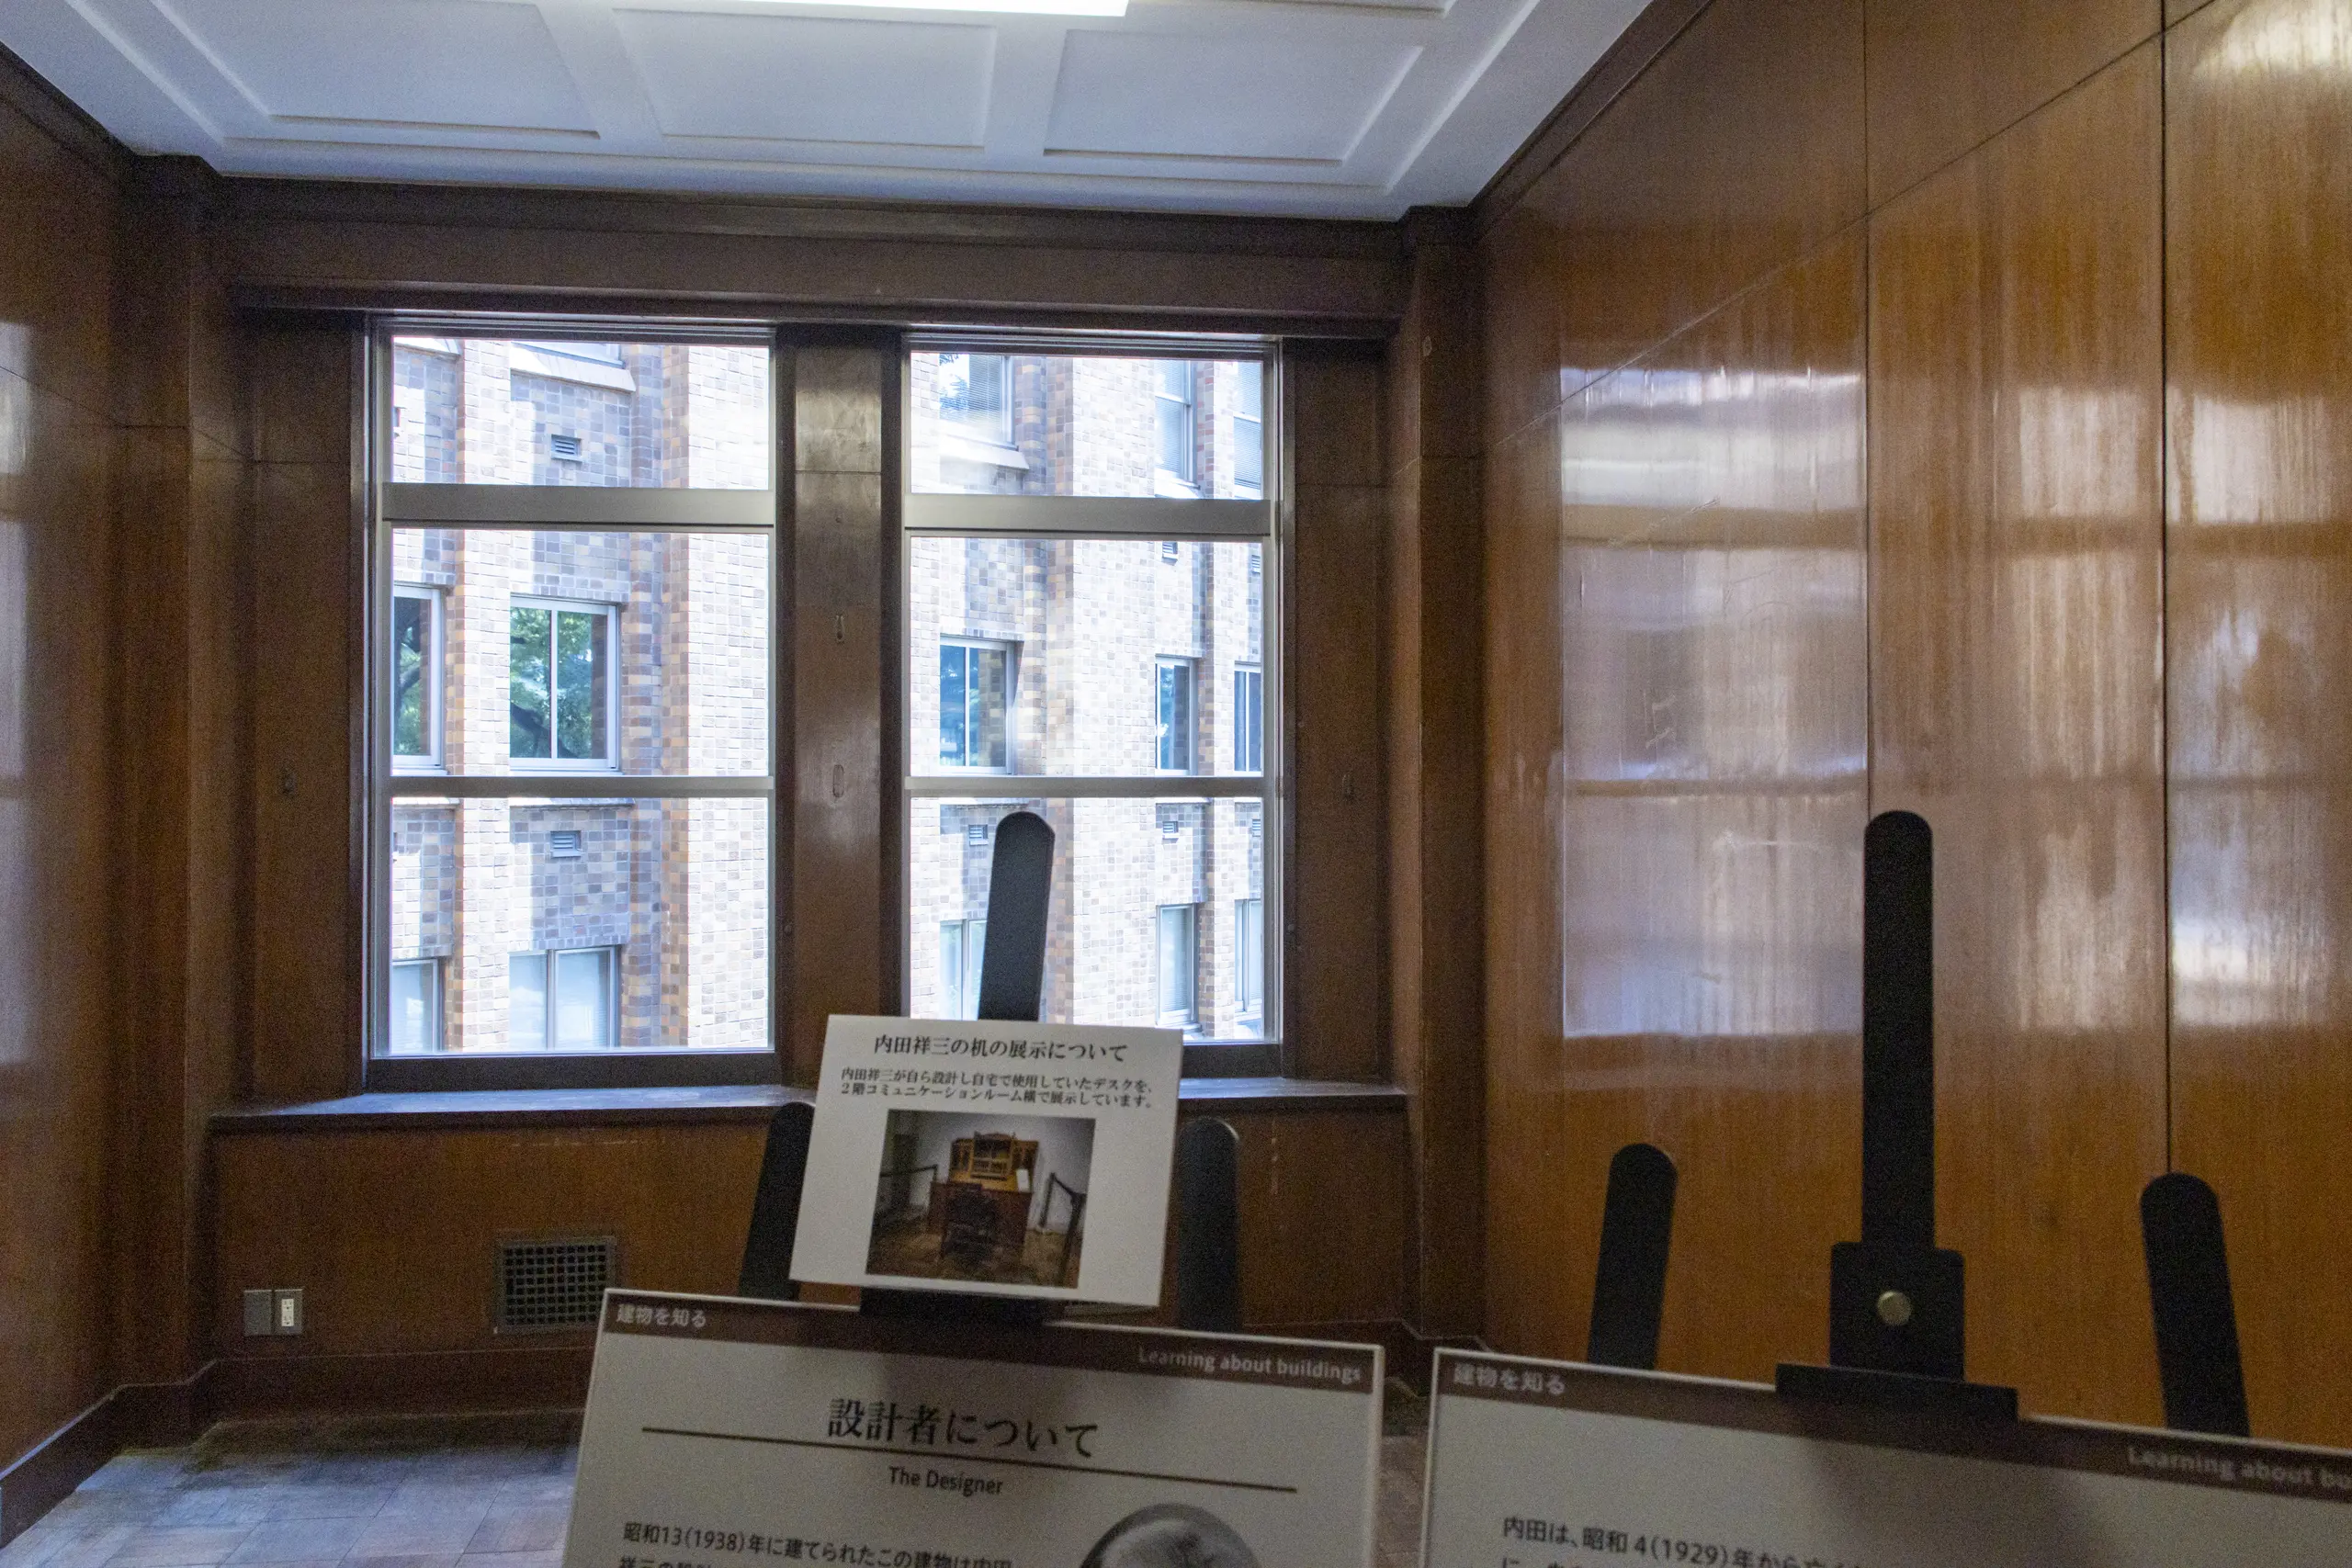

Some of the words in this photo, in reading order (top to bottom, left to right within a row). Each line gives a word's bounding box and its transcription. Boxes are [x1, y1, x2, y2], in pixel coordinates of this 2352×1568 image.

[874, 1033, 1128, 1063] 内田祥三の机の展示について
[616, 1303, 707, 1329] 建物を知る
[1137, 1346, 1216, 1372] Learning
[1219, 1353, 1272, 1375] about
[1276, 1358, 1362, 1386] buildings
[1453, 1360, 1566, 1396] 建物を知る
[828, 1397, 1098, 1458] 設計者について
[888, 1467, 920, 1487] The
[925, 1470, 1003, 1497] Designer
[2127, 1446, 2236, 1482] Learning
[2240, 1459, 2313, 1485] about
